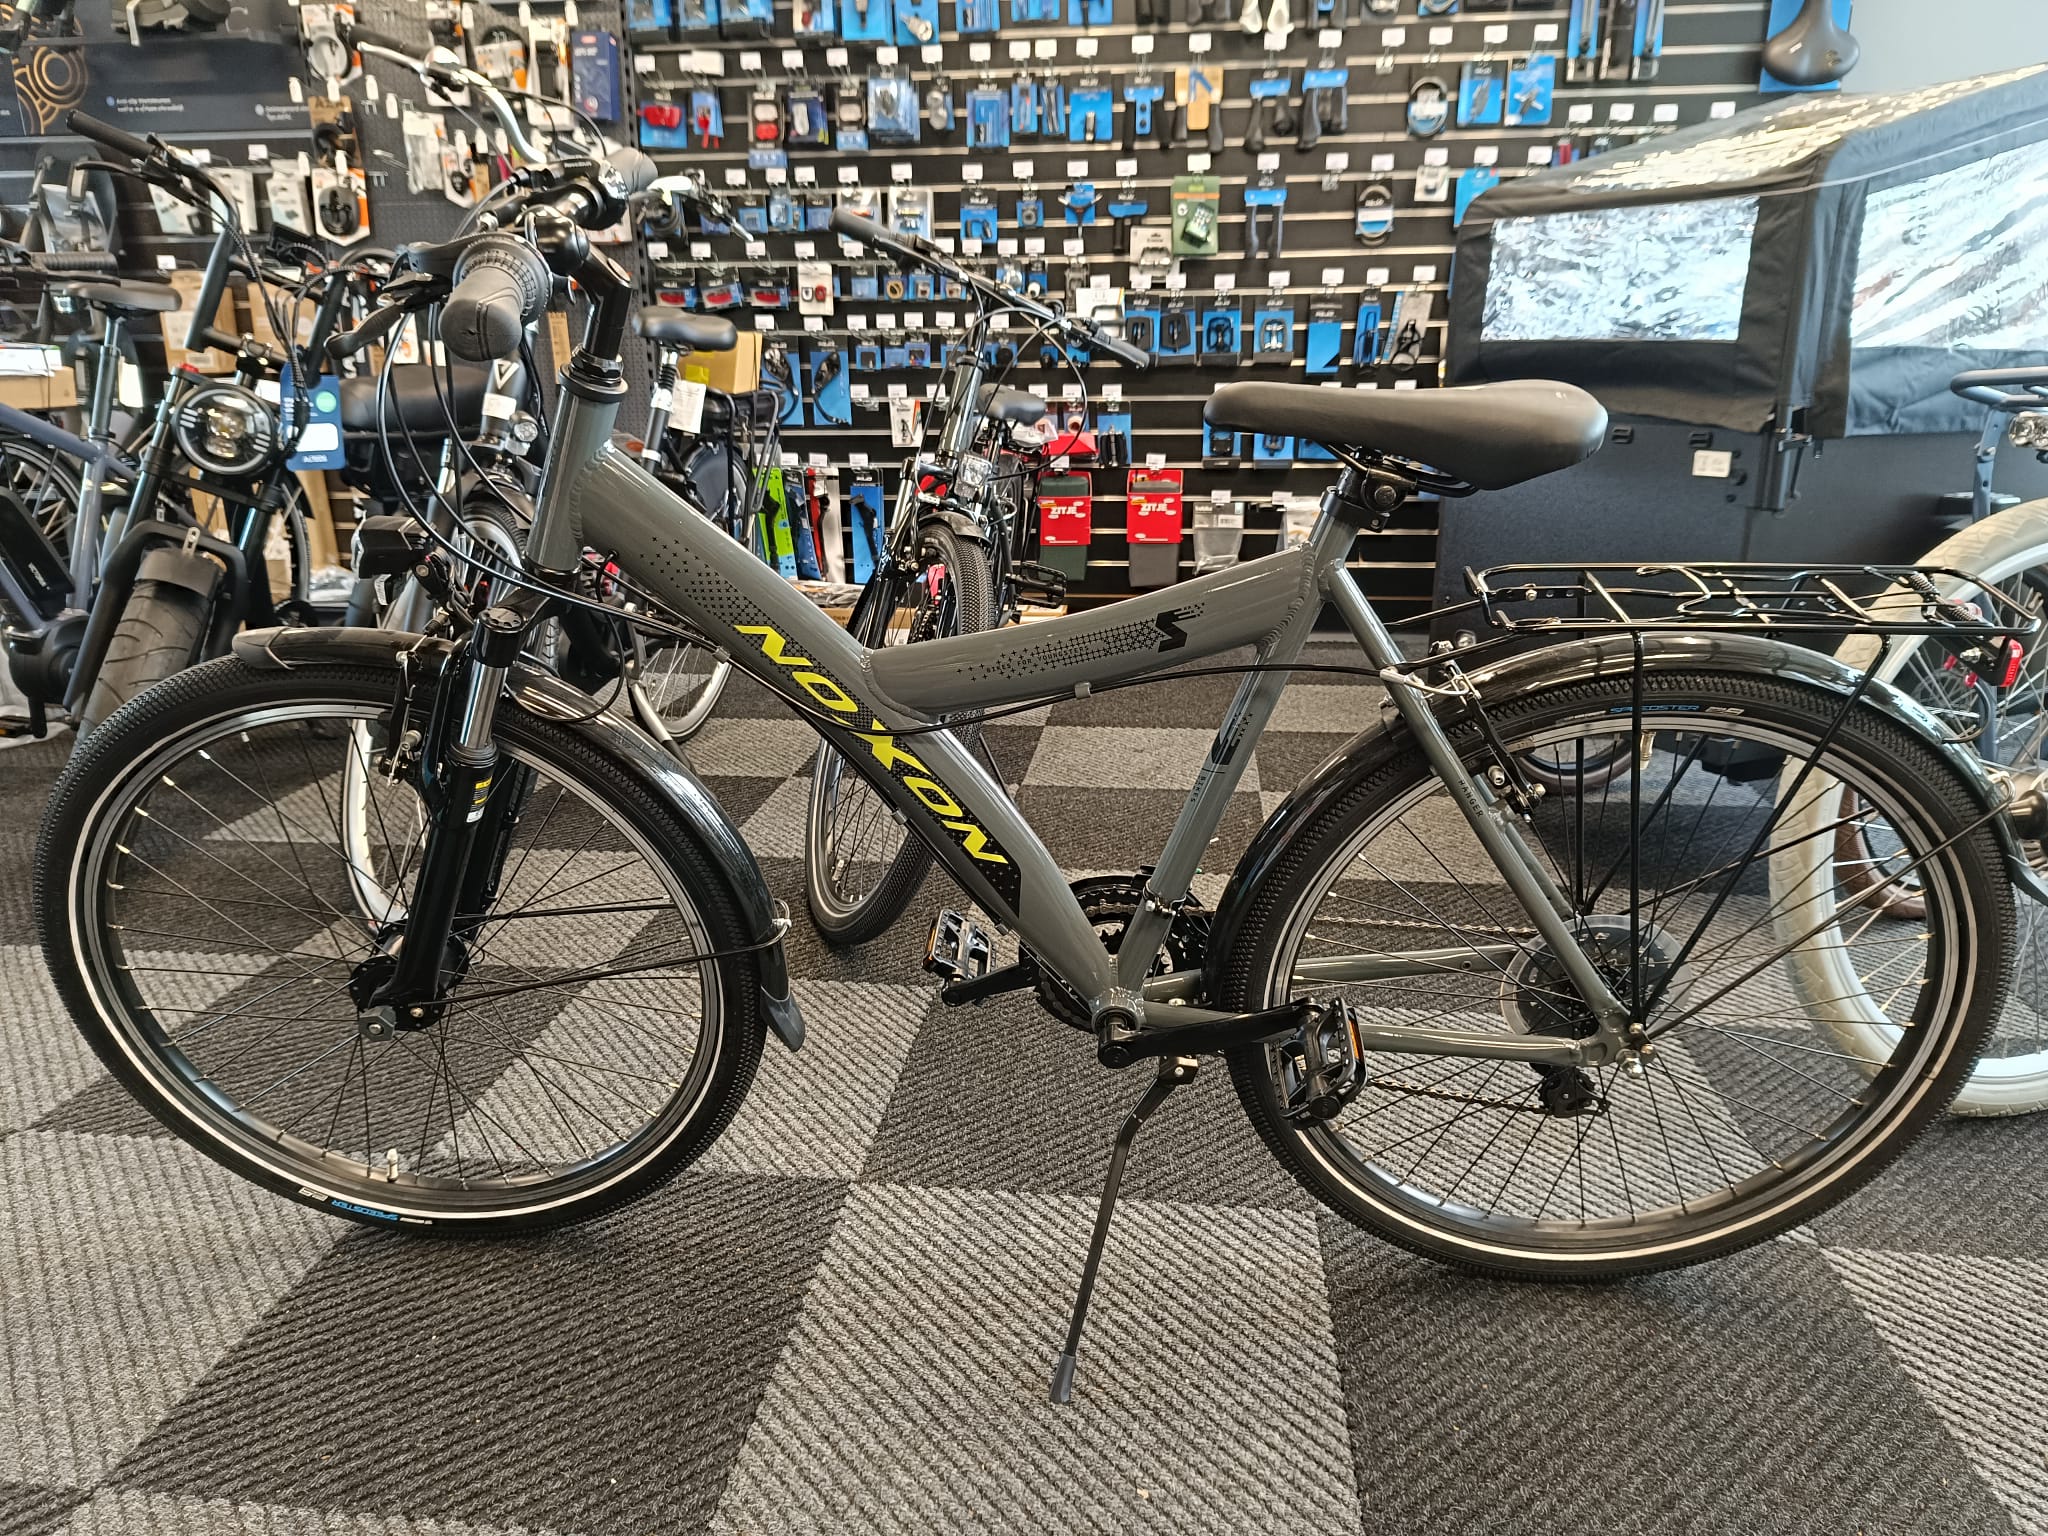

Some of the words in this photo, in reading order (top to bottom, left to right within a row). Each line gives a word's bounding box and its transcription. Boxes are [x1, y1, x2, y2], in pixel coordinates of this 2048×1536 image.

[986, 662, 1011, 673] BIKES
[1017, 657, 1033, 667] FOR
[1037, 644, 1090, 662] YOUNGSTERS
[733, 624, 1009, 865] NOXON
